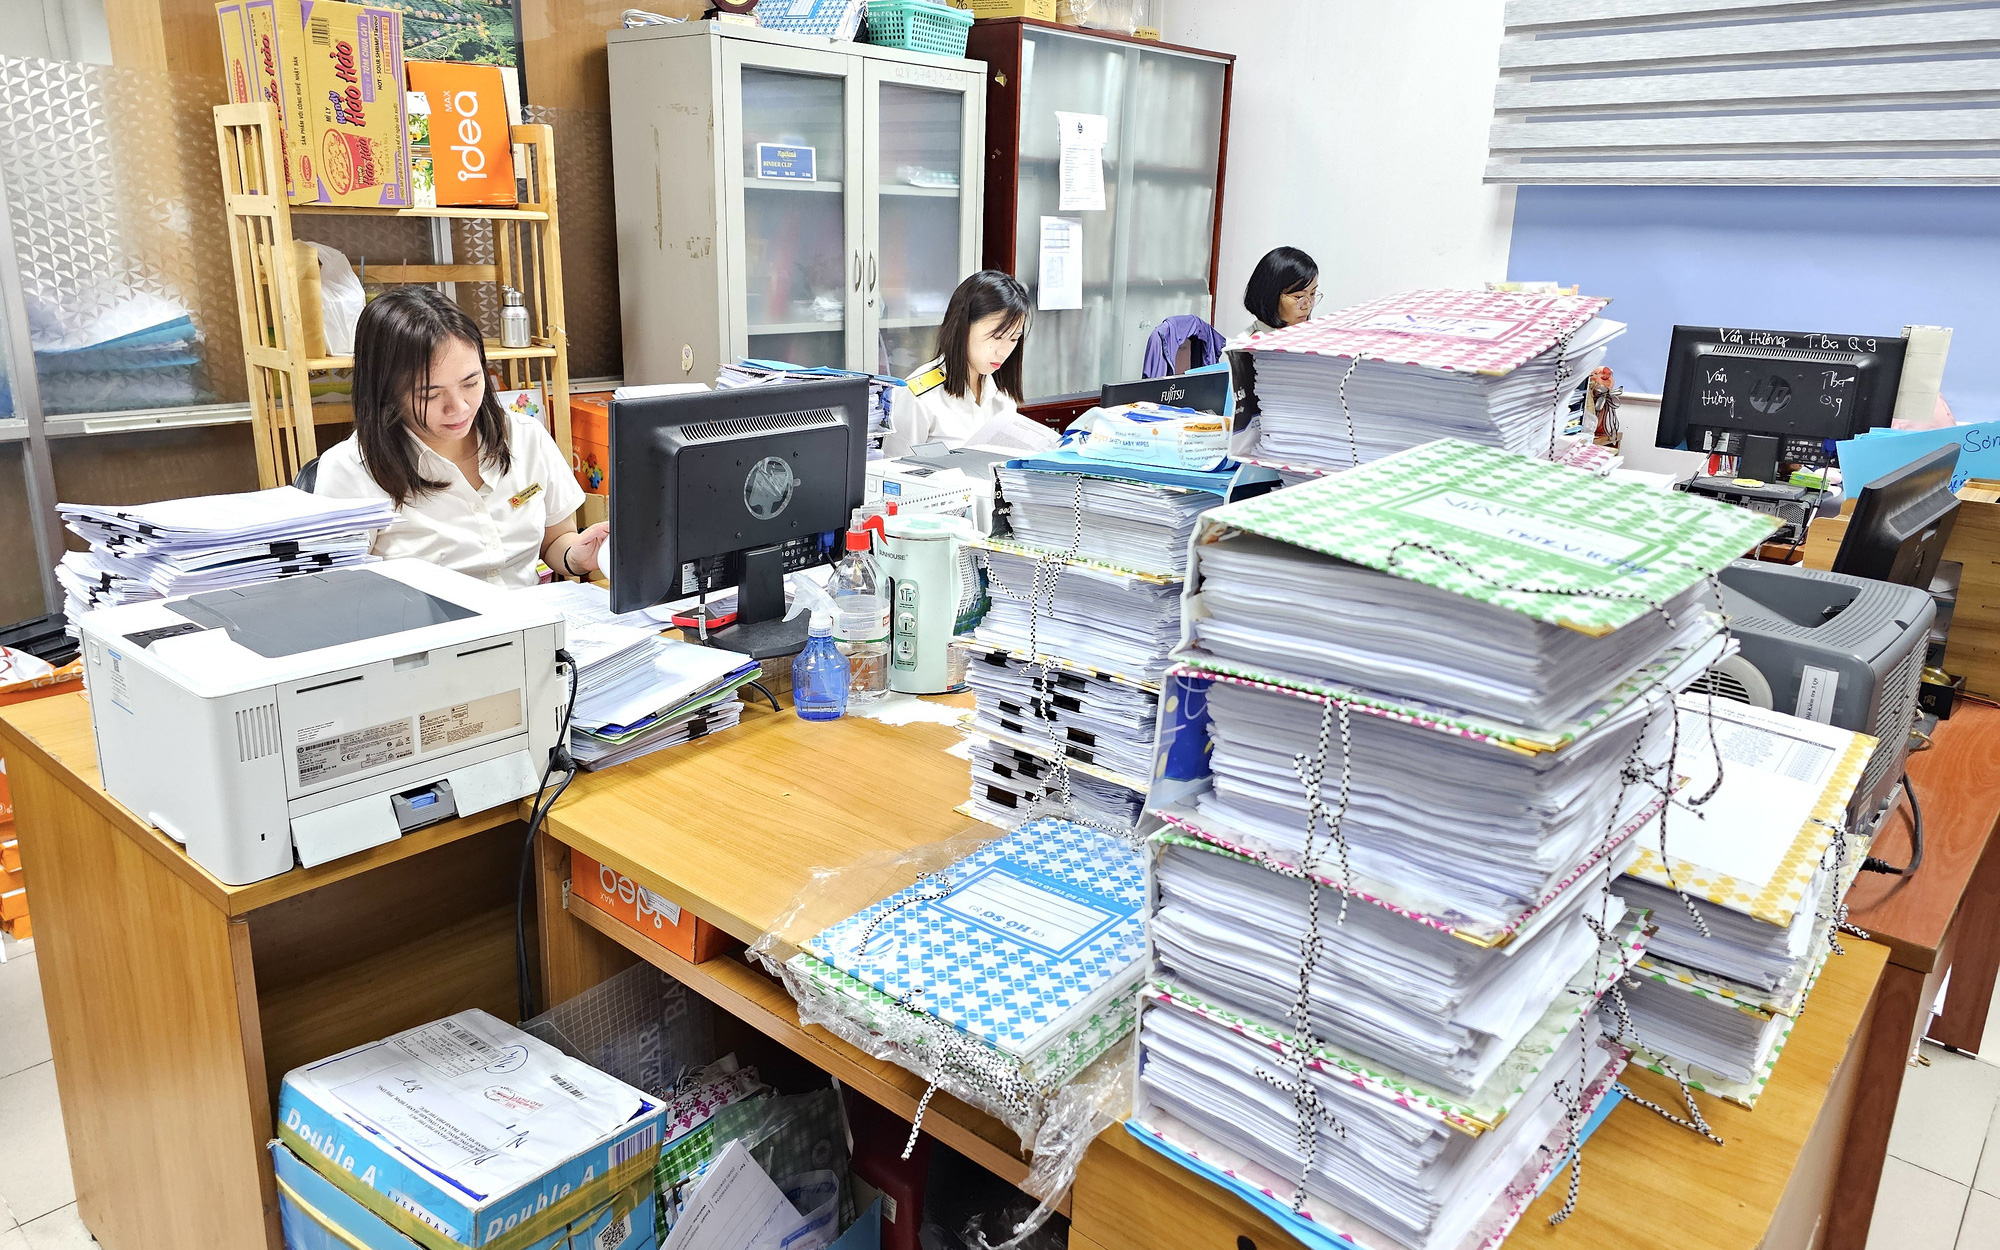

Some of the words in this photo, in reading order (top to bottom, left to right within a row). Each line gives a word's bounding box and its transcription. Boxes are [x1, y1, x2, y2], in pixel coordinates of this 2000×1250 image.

[260, 34, 275, 76] Hảo
[330, 40, 358, 83] Hảo
[361, 59, 370, 74] TÔM
[329, 90, 347, 124] Handy
[341, 85, 366, 127] Hảo
[443, 90, 453, 113] MAX
[449, 90, 488, 182] idea
[1160, 388, 1185, 404] FUJITSU
[1122, 439, 1135, 447] BABY
[1135, 440, 1150, 448] WIPES
[600, 892, 615, 907] MAX
[979, 910, 1005, 923] SƠ
[1002, 920, 1032, 934] HỒ
[639, 1023, 660, 1090] EAR
[285, 1107, 356, 1172] Double
[359, 1164, 377, 1189] A
[387, 1190, 450, 1235] EVERYDAY
[485, 1182, 571, 1243] Double
[579, 1164, 595, 1189] A
